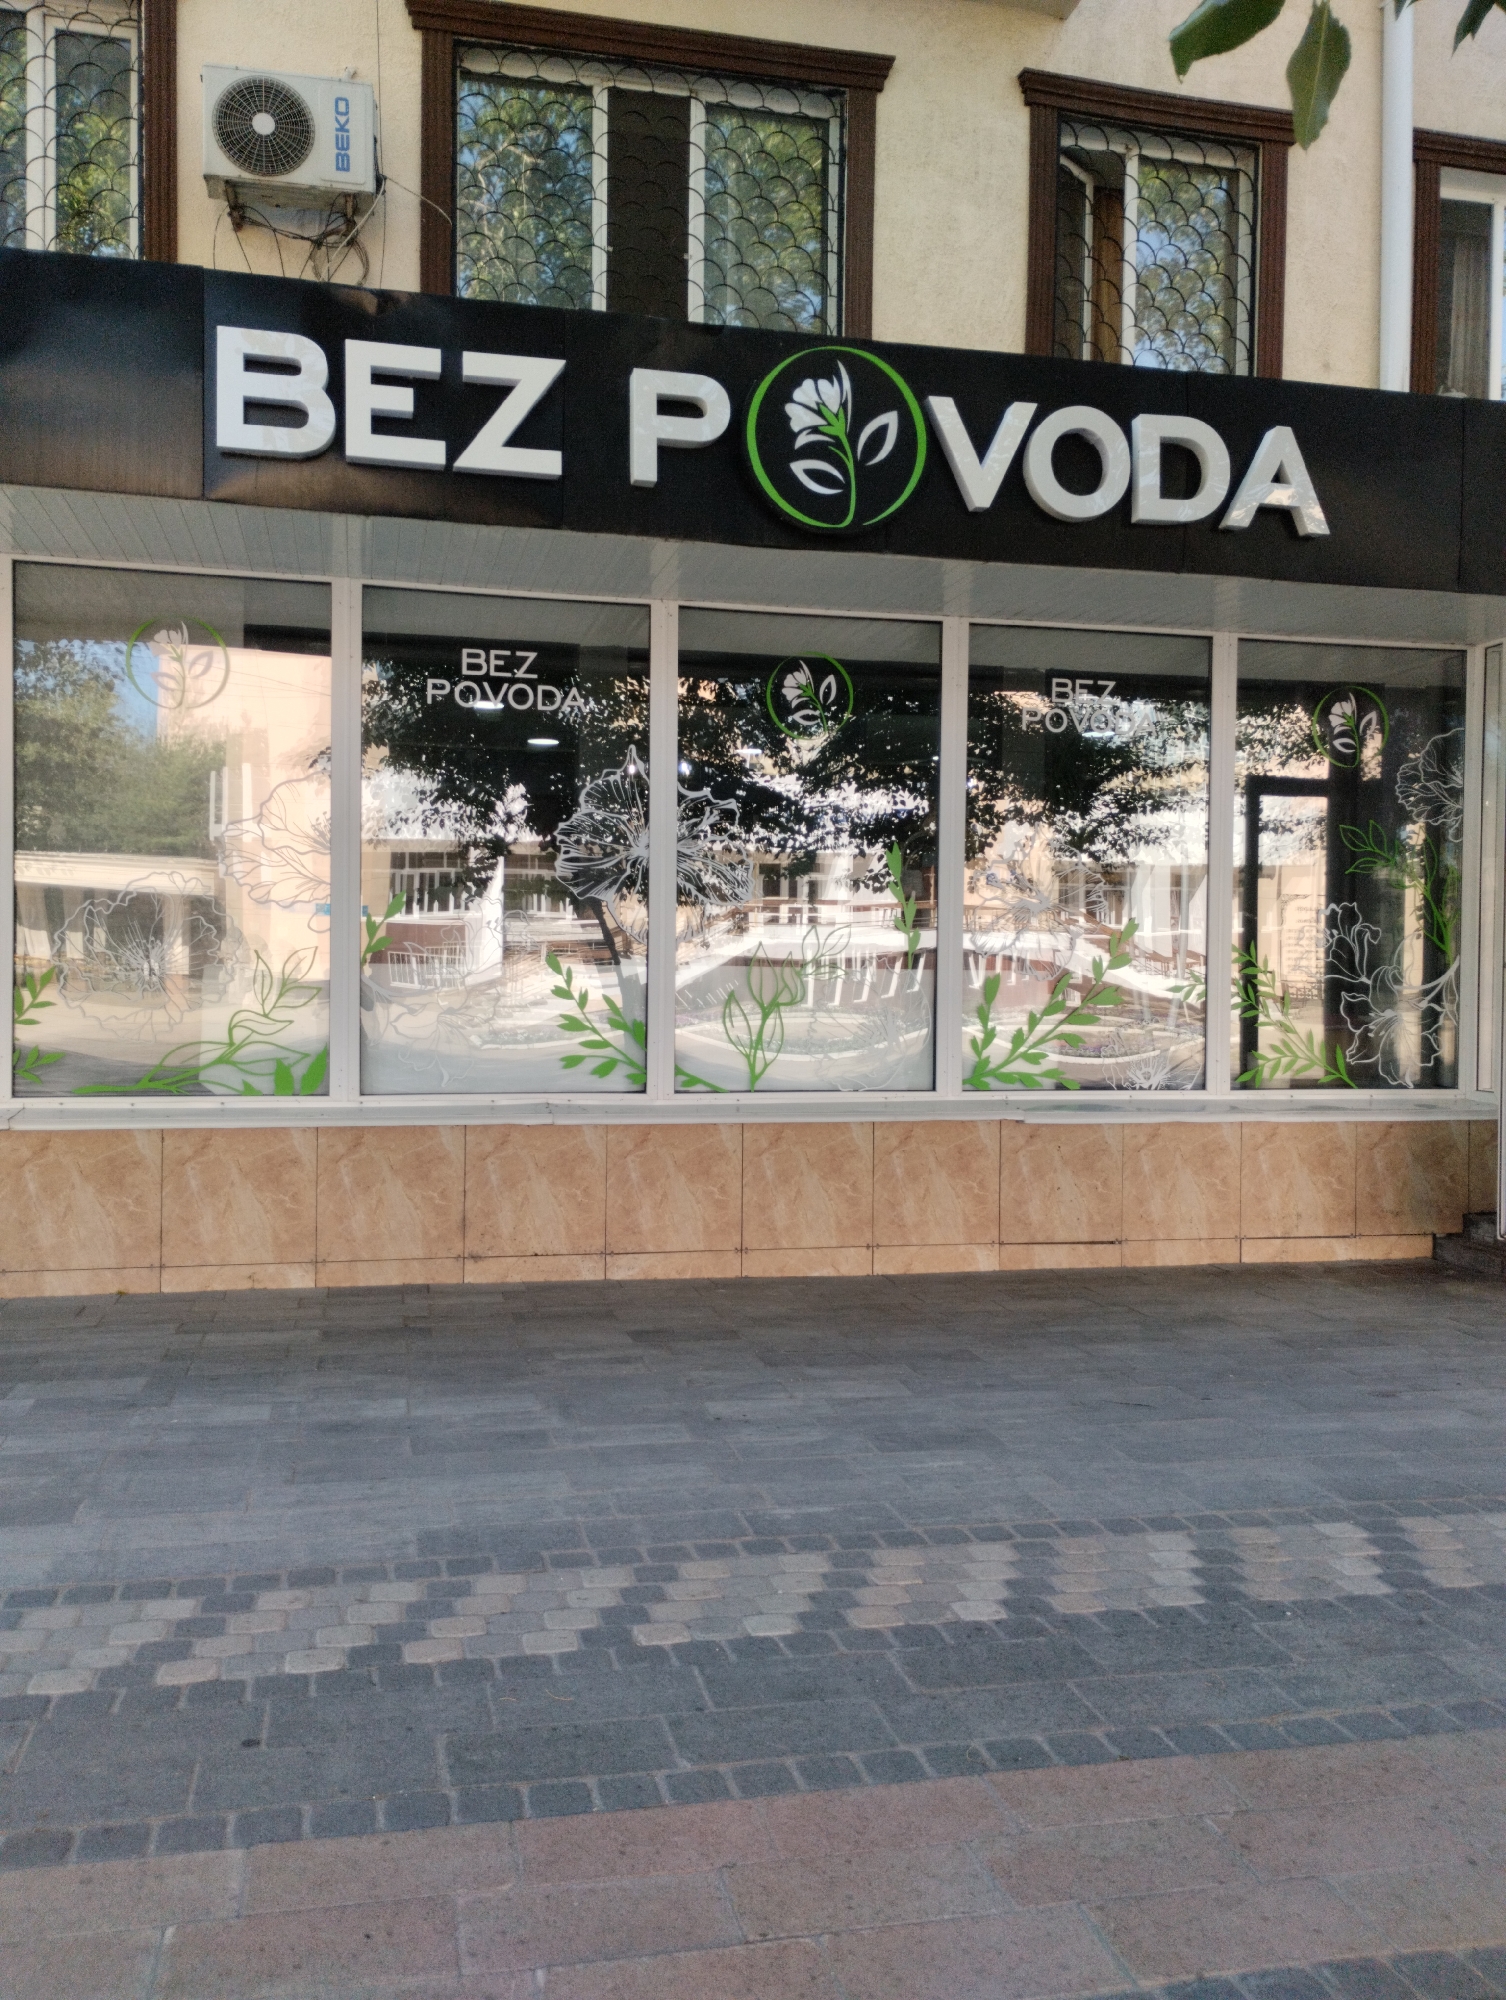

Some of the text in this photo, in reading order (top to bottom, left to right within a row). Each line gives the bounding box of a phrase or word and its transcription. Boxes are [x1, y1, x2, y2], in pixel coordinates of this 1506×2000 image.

[335, 96, 350, 172] BEKO
[216, 325, 566, 479] BEZ
[462, 648, 538, 679] BEZ
[427, 678, 586, 712] POVODA
[1052, 678, 1117, 705] BEZ
[1022, 707, 1157, 736] POVODA
